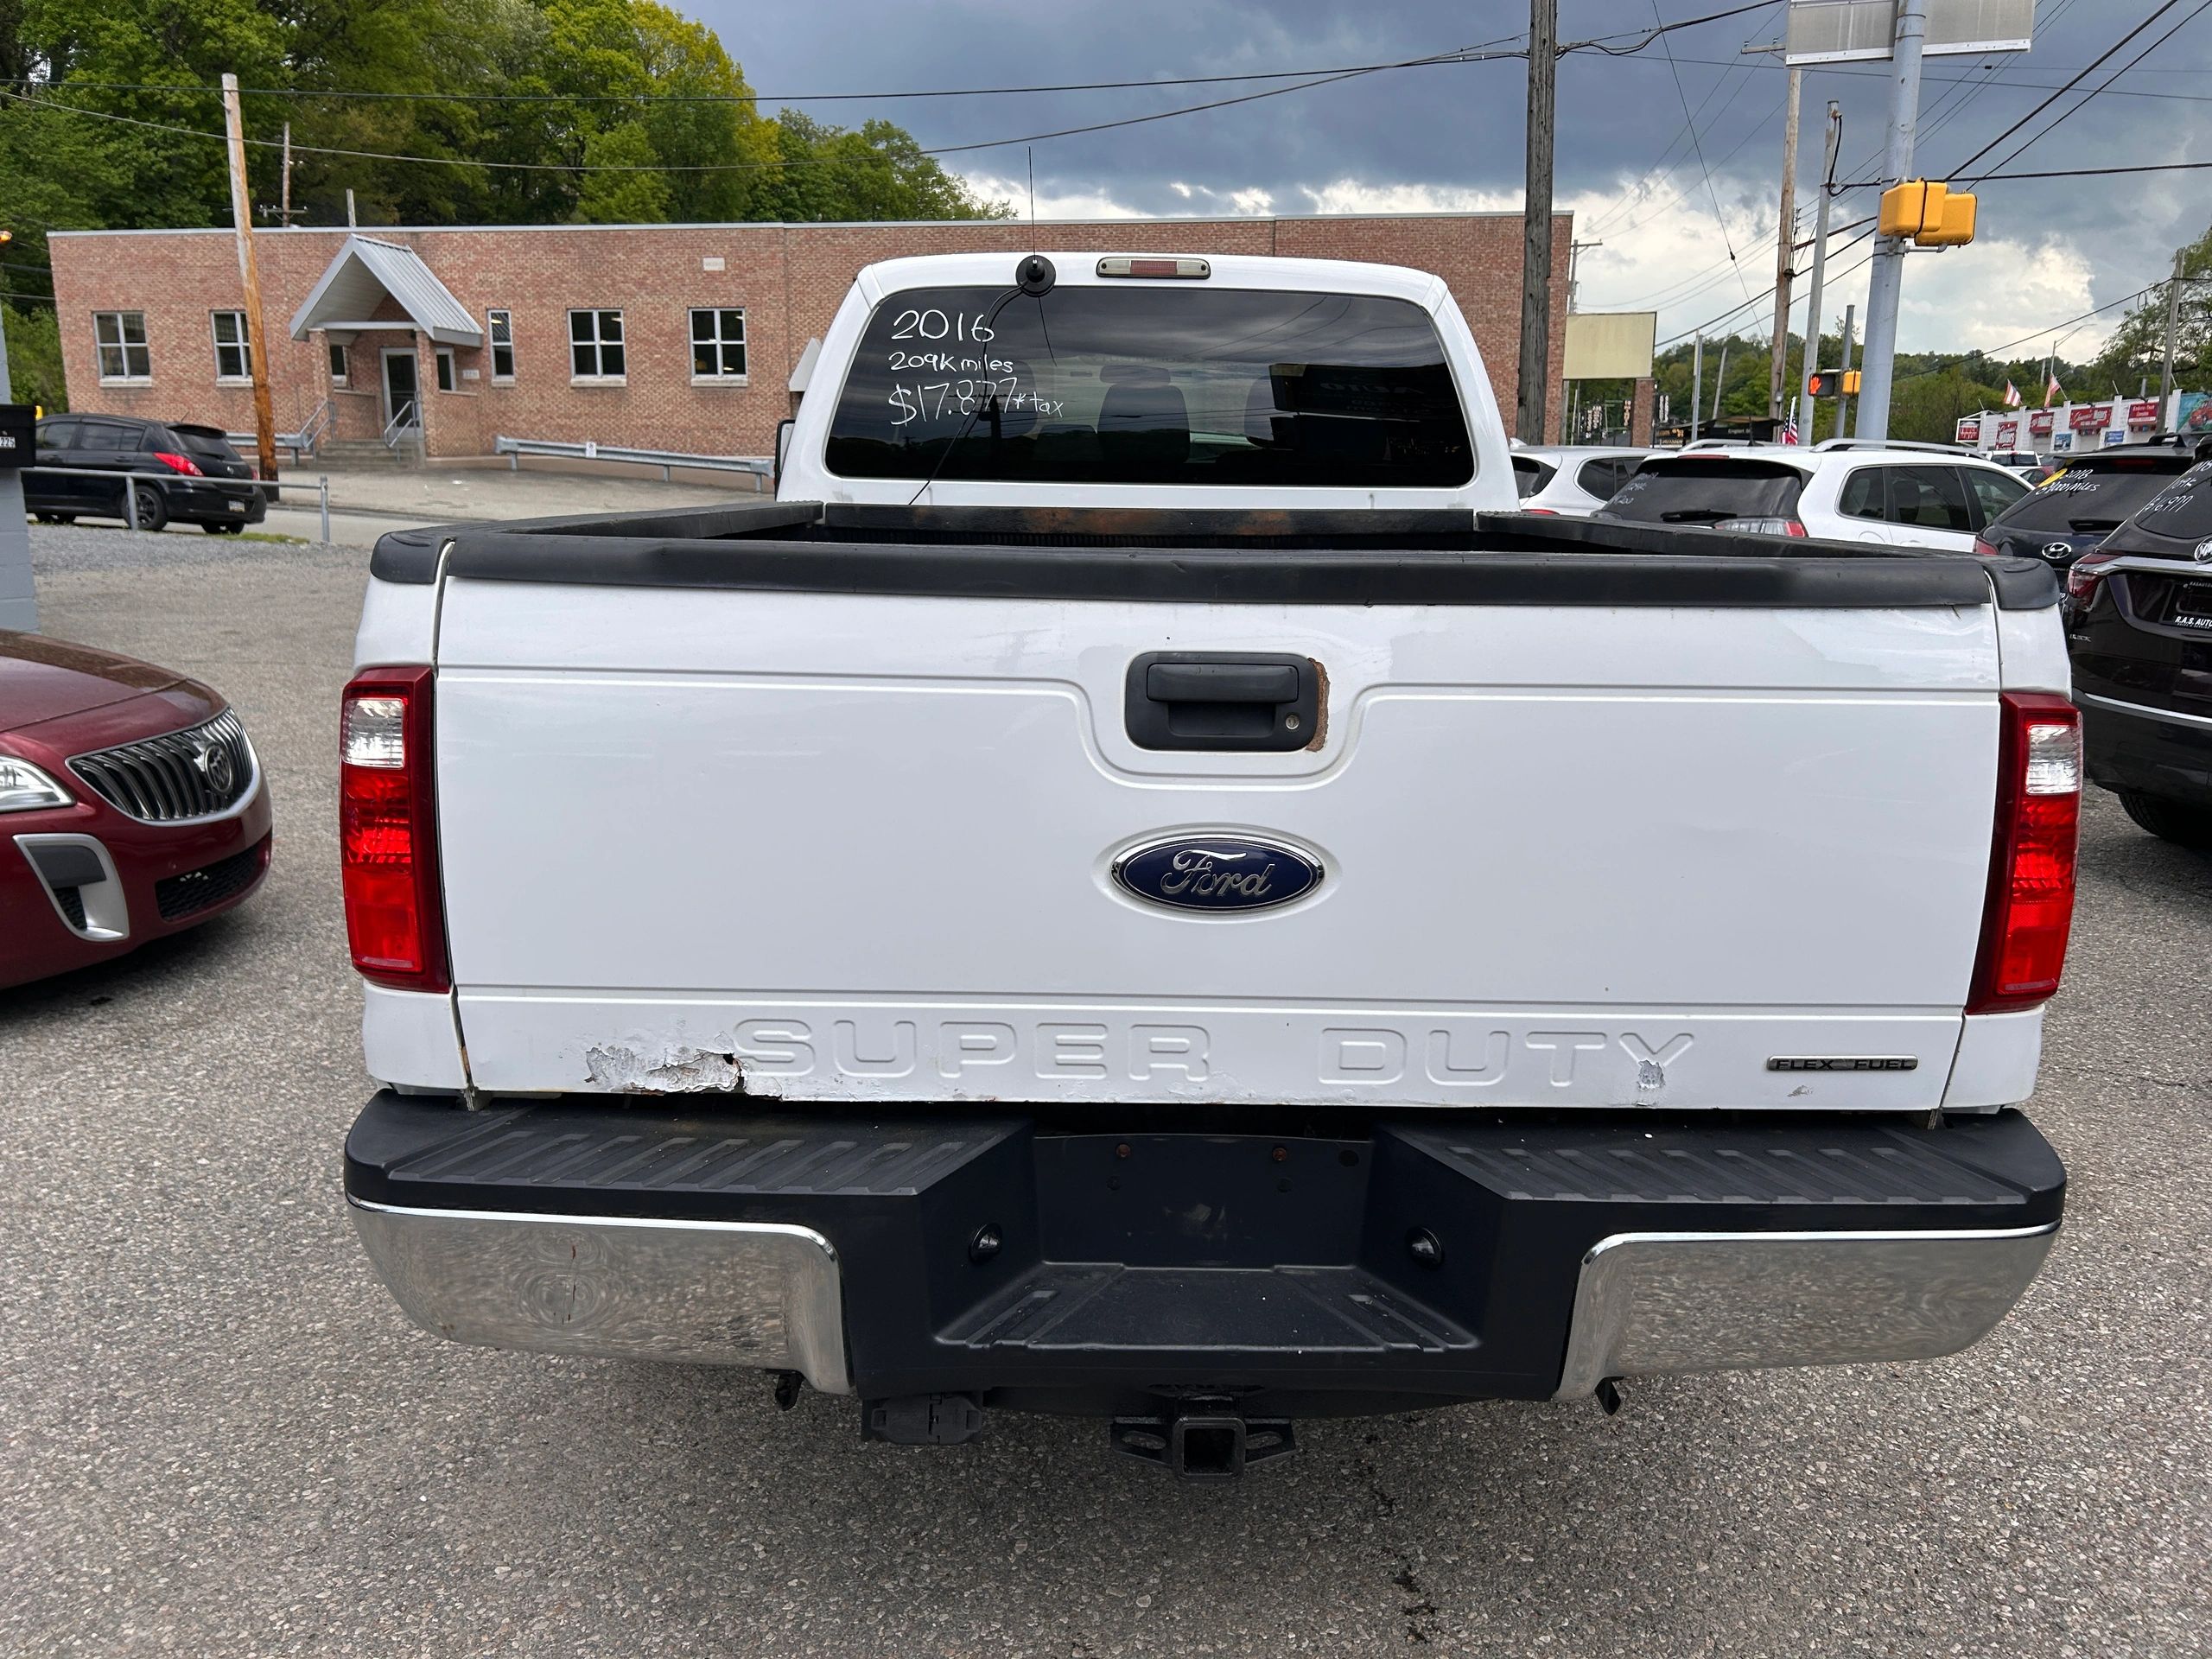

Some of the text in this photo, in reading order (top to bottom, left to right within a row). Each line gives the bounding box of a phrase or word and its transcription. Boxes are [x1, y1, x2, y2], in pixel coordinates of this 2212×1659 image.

[891, 309, 995, 343] 2016
[1160, 849, 1275, 897] Ford
[733, 1018, 1695, 1089] SUPER DUTY
[1776, 1059, 1913, 1071] FLEX FUEL
